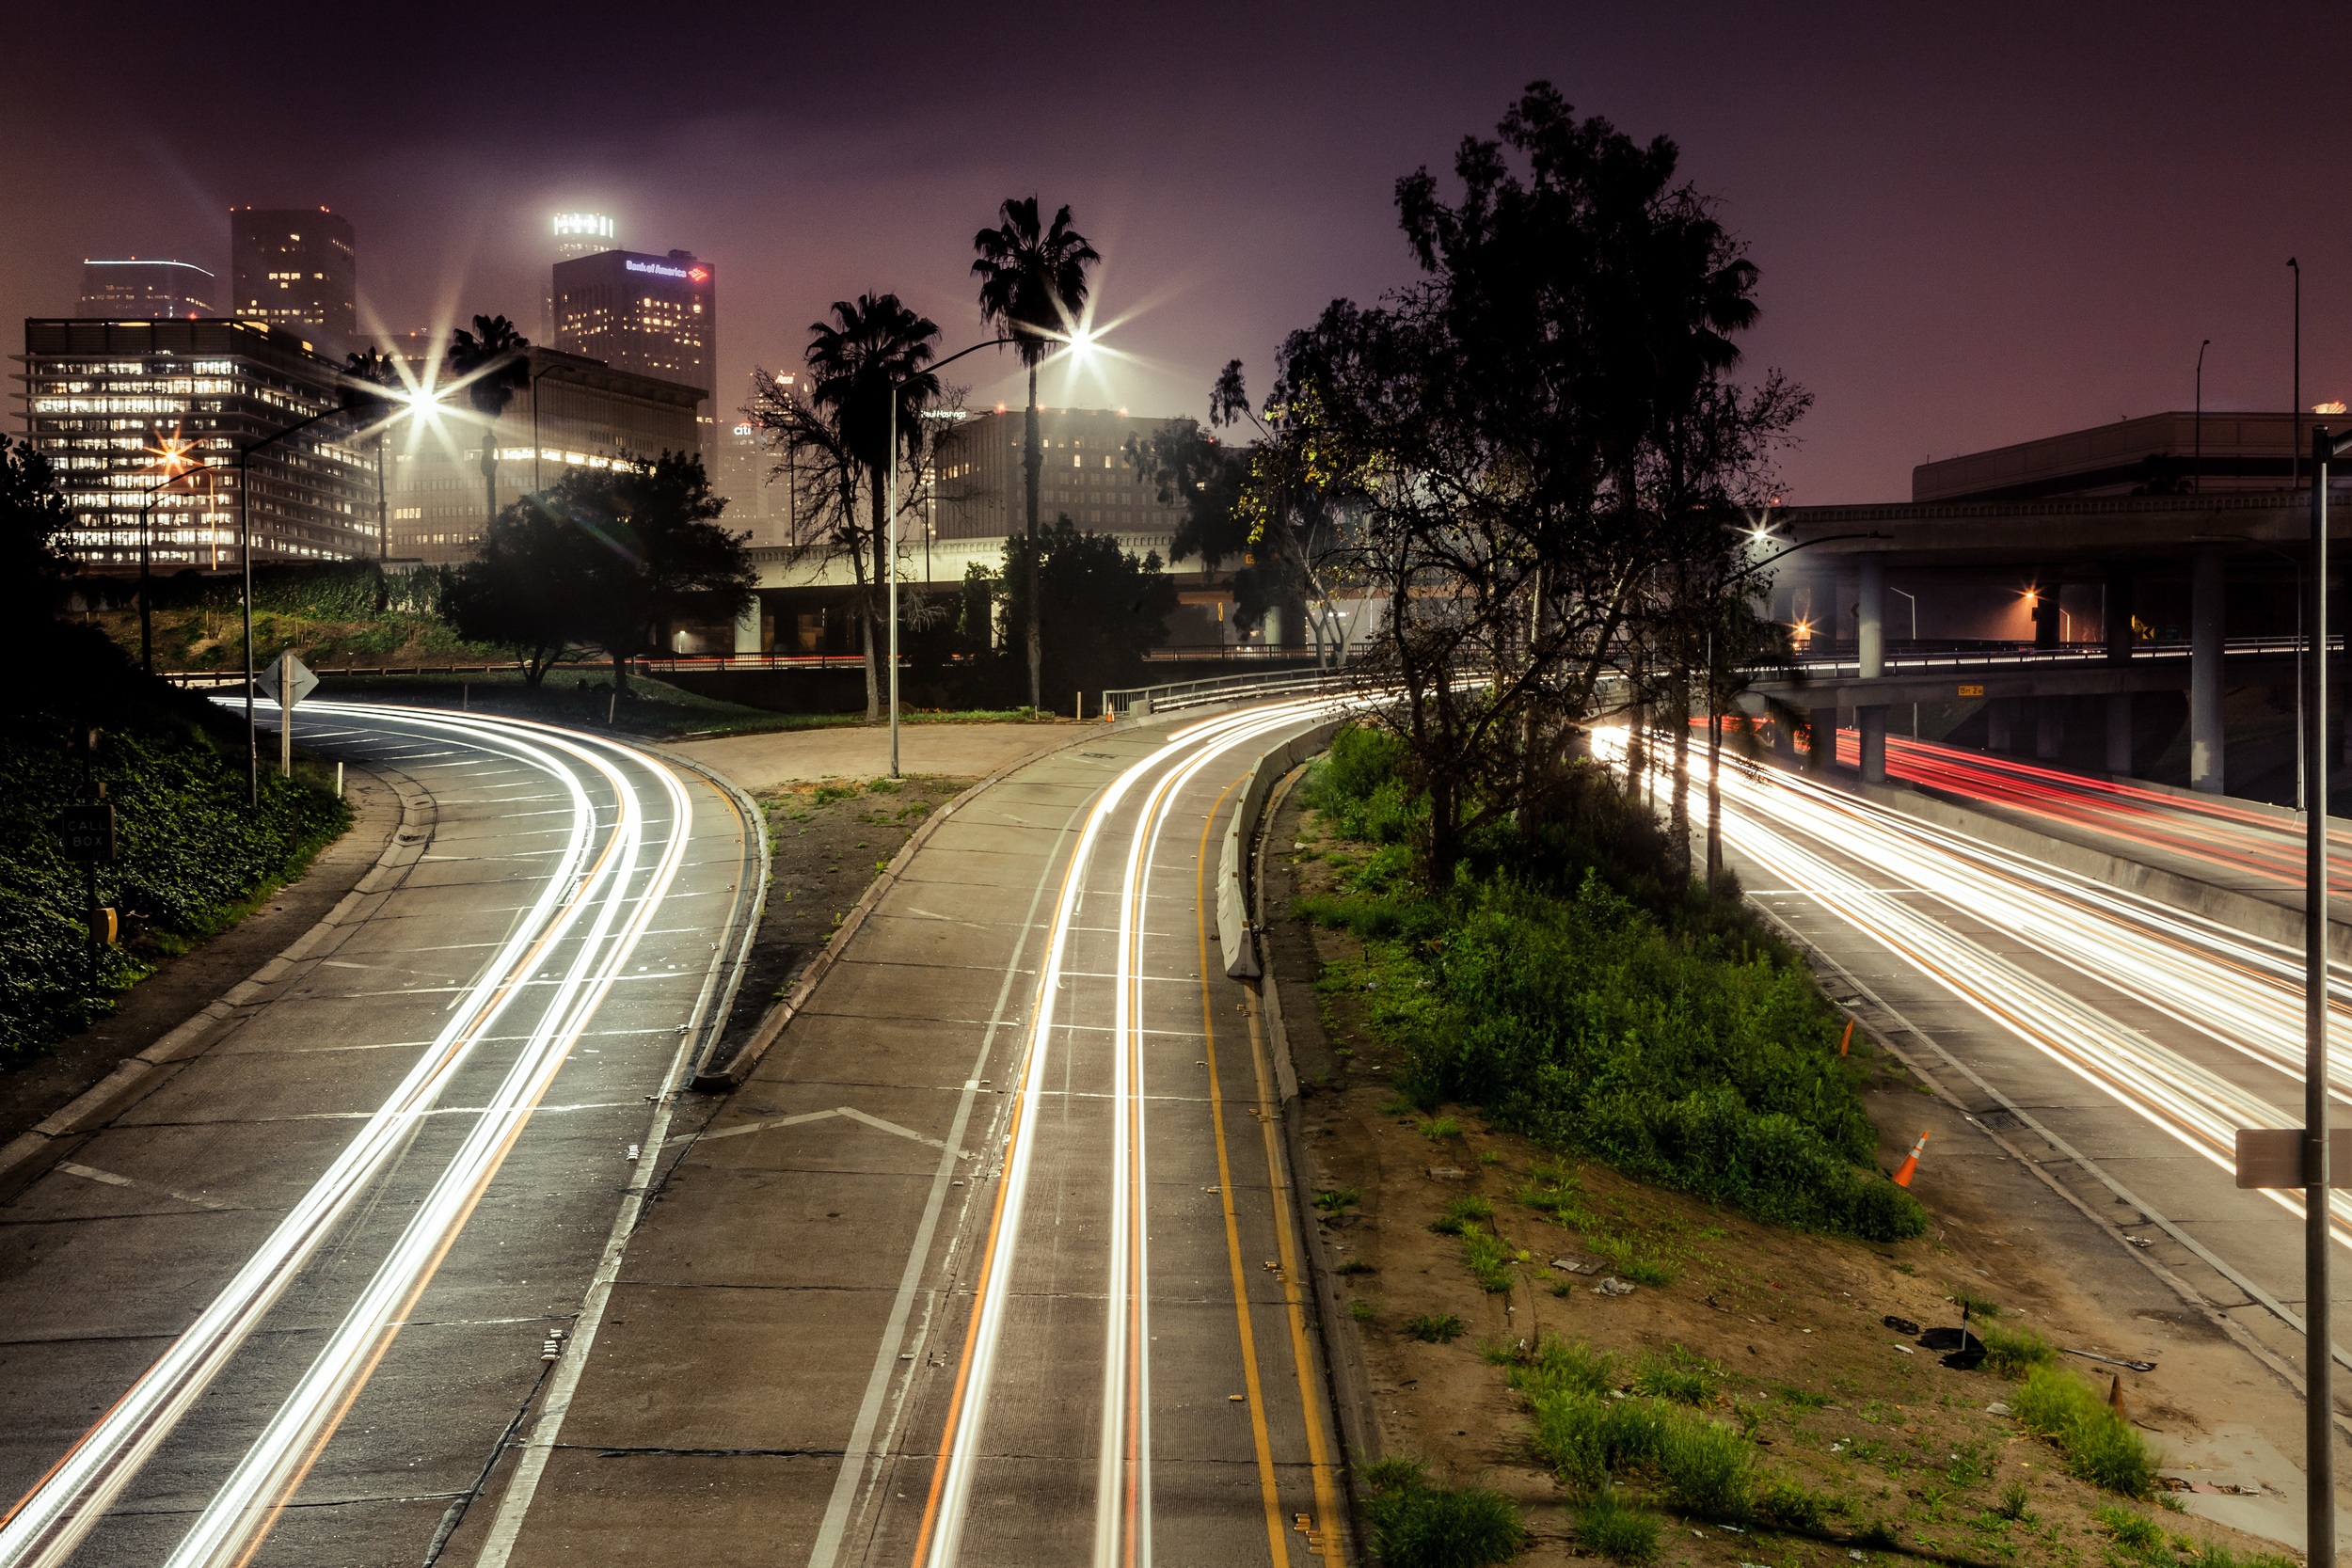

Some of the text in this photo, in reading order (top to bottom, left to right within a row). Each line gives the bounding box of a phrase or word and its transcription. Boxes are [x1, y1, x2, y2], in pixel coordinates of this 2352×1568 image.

[626, 260, 687, 277] Bank of America
[733, 424, 751, 436] citi
[68, 820, 107, 832] CALL
[73, 836, 103, 847] BOX
